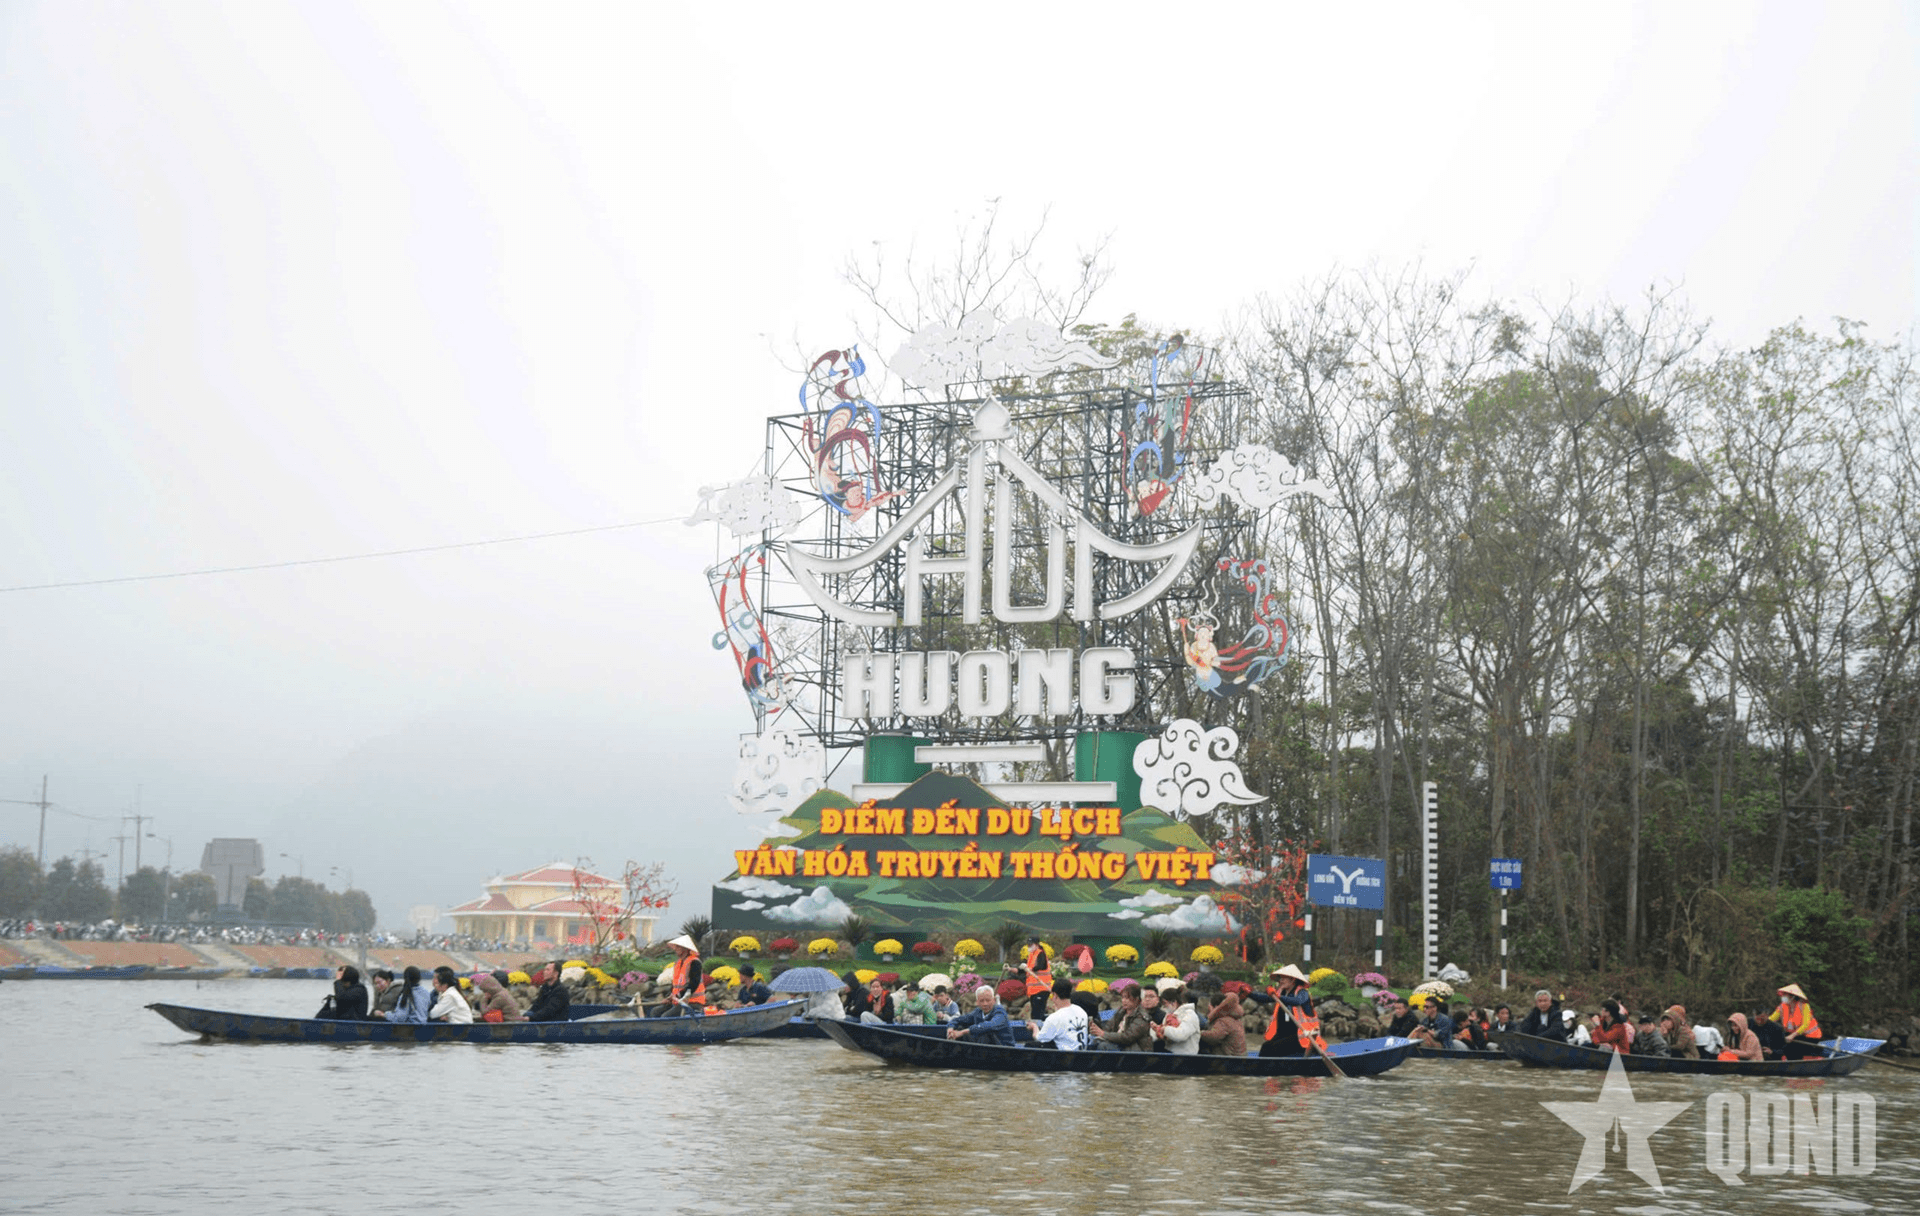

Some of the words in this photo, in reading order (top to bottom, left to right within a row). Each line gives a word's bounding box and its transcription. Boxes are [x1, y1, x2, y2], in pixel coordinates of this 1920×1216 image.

[843, 647, 1136, 718] HƯƠNG
[820, 799, 906, 835] ĐIỂM
[912, 799, 981, 835] ĐẾN
[986, 807, 1033, 835] DU
[1039, 807, 1122, 841] LỊCH
[734, 844, 798, 877] VĂN
[802, 844, 870, 877] HÓA
[876, 841, 1003, 879] TRUYỀN
[1010, 842, 1127, 880] THỐNG
[1135, 846, 1216, 886] VIỆT
